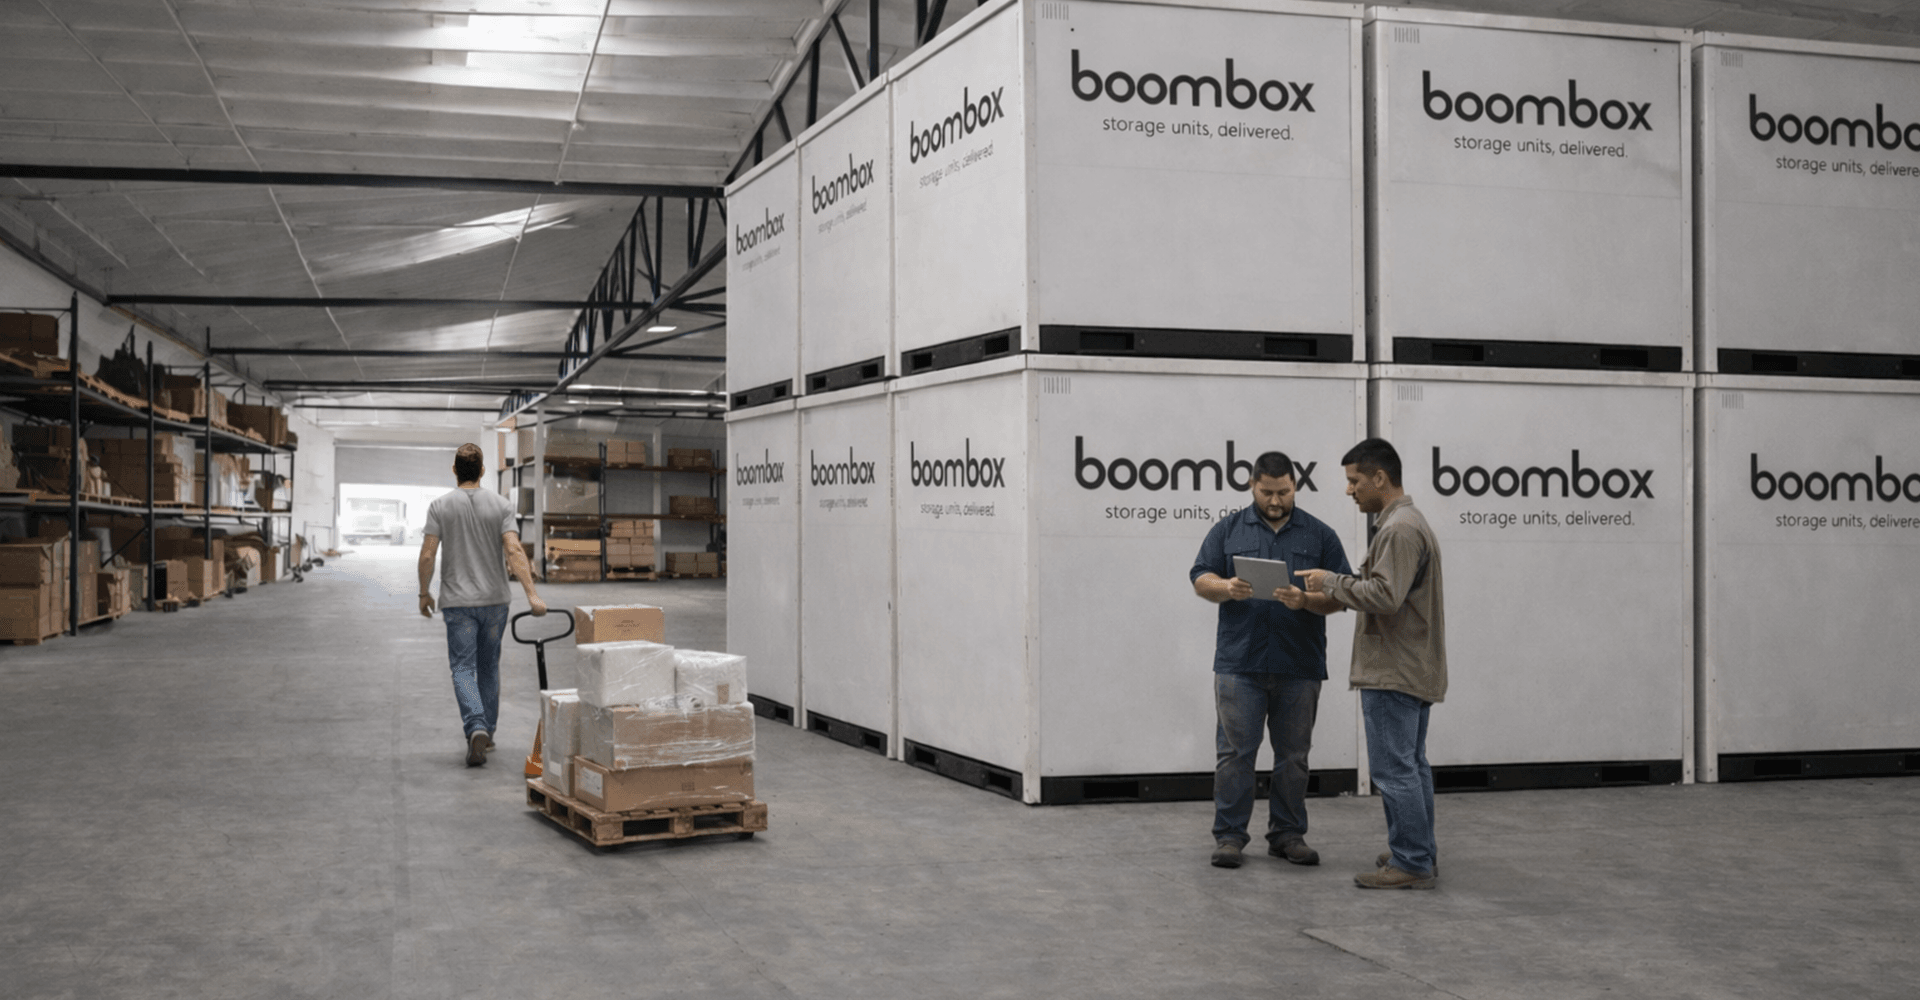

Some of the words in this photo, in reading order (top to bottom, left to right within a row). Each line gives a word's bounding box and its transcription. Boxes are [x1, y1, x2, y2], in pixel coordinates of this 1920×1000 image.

[1071, 48, 1316, 112] boombox
[1422, 70, 1653, 131] boombox
[910, 86, 1004, 164] boombox
[1102, 116, 1166, 137] storage
[1171, 119, 1213, 139] units,
[1217, 121, 1295, 141] delivered.
[1453, 135, 1512, 155] storage
[1517, 138, 1556, 156] units,
[1559, 141, 1628, 158] delivered.
[812, 153, 874, 214] boombox
[1775, 156, 1827, 175] storage
[1831, 159, 1867, 177] units,
[736, 207, 785, 255] boombox
[736, 448, 785, 486] boombox
[811, 446, 876, 487] boombox
[910, 438, 1006, 488] boombox
[1074, 435, 1319, 492] boombx
[1432, 446, 1655, 499] boombox
[1105, 505, 1168, 524] storage
[1173, 504, 1215, 523] units,
[1459, 510, 1518, 529] storage
[1522, 509, 1562, 528] units,
[1565, 510, 1635, 527] delivered.
[1775, 514, 1828, 531] storage
[1831, 513, 1867, 530] units,
